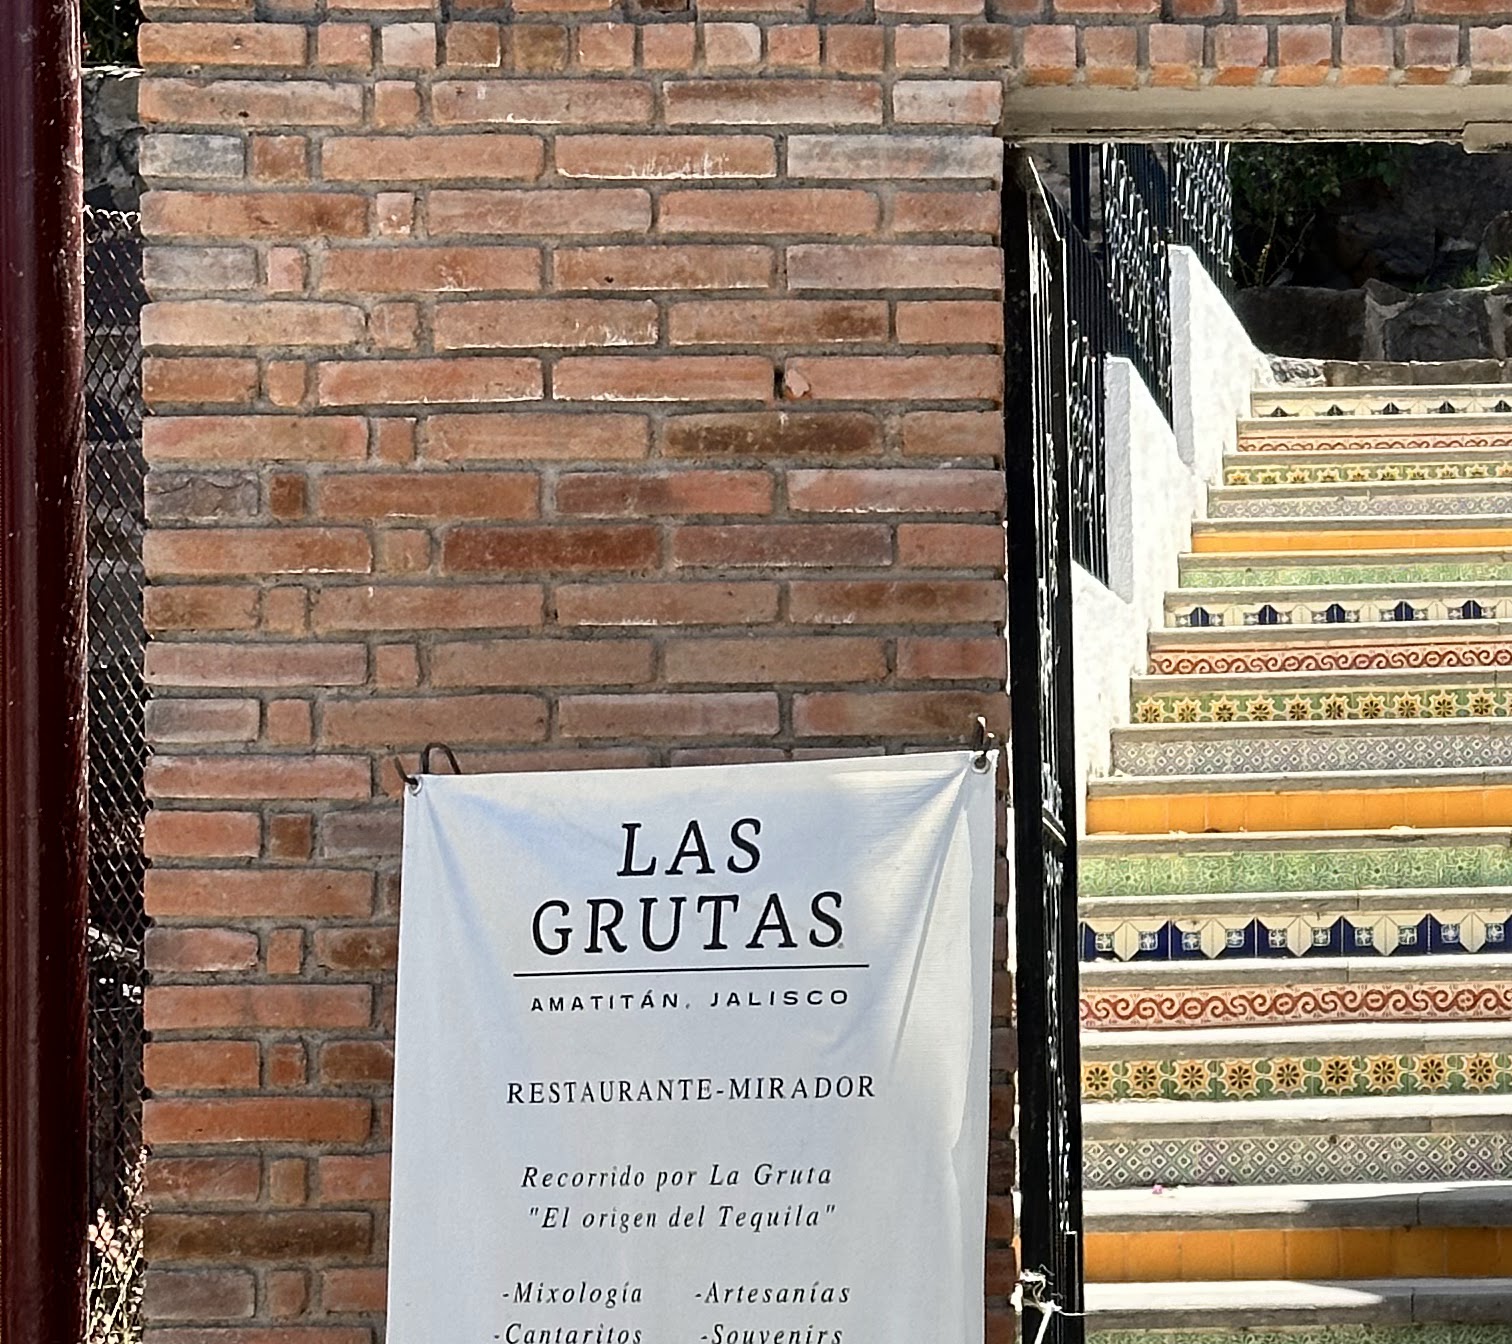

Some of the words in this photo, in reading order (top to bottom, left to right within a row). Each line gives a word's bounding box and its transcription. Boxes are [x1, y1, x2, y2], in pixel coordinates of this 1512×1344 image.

[617, 818, 760, 876] LAS
[532, 891, 840, 955] GRUTAS
[711, 990, 847, 1007] JALISCO
[507, 1076, 875, 1103] RESTAURANTE-MIRADOR
[522, 1165, 644, 1187] Recorrido
[657, 1172, 696, 1192] por
[710, 1164, 738, 1185] La
[755, 1164, 830, 1185] Gruta
[531, 1207, 569, 1228] "El
[582, 1209, 657, 1234] origen
[669, 1205, 704, 1227] del
[720, 1205, 835, 1232] Tequila"
[503, 1282, 641, 1308] -Mixología
[696, 1282, 849, 1303] -Artesanías
[495, 1324, 641, 1344] -Cantaritos
[701, 1324, 842, 1344] -Souvenirs
